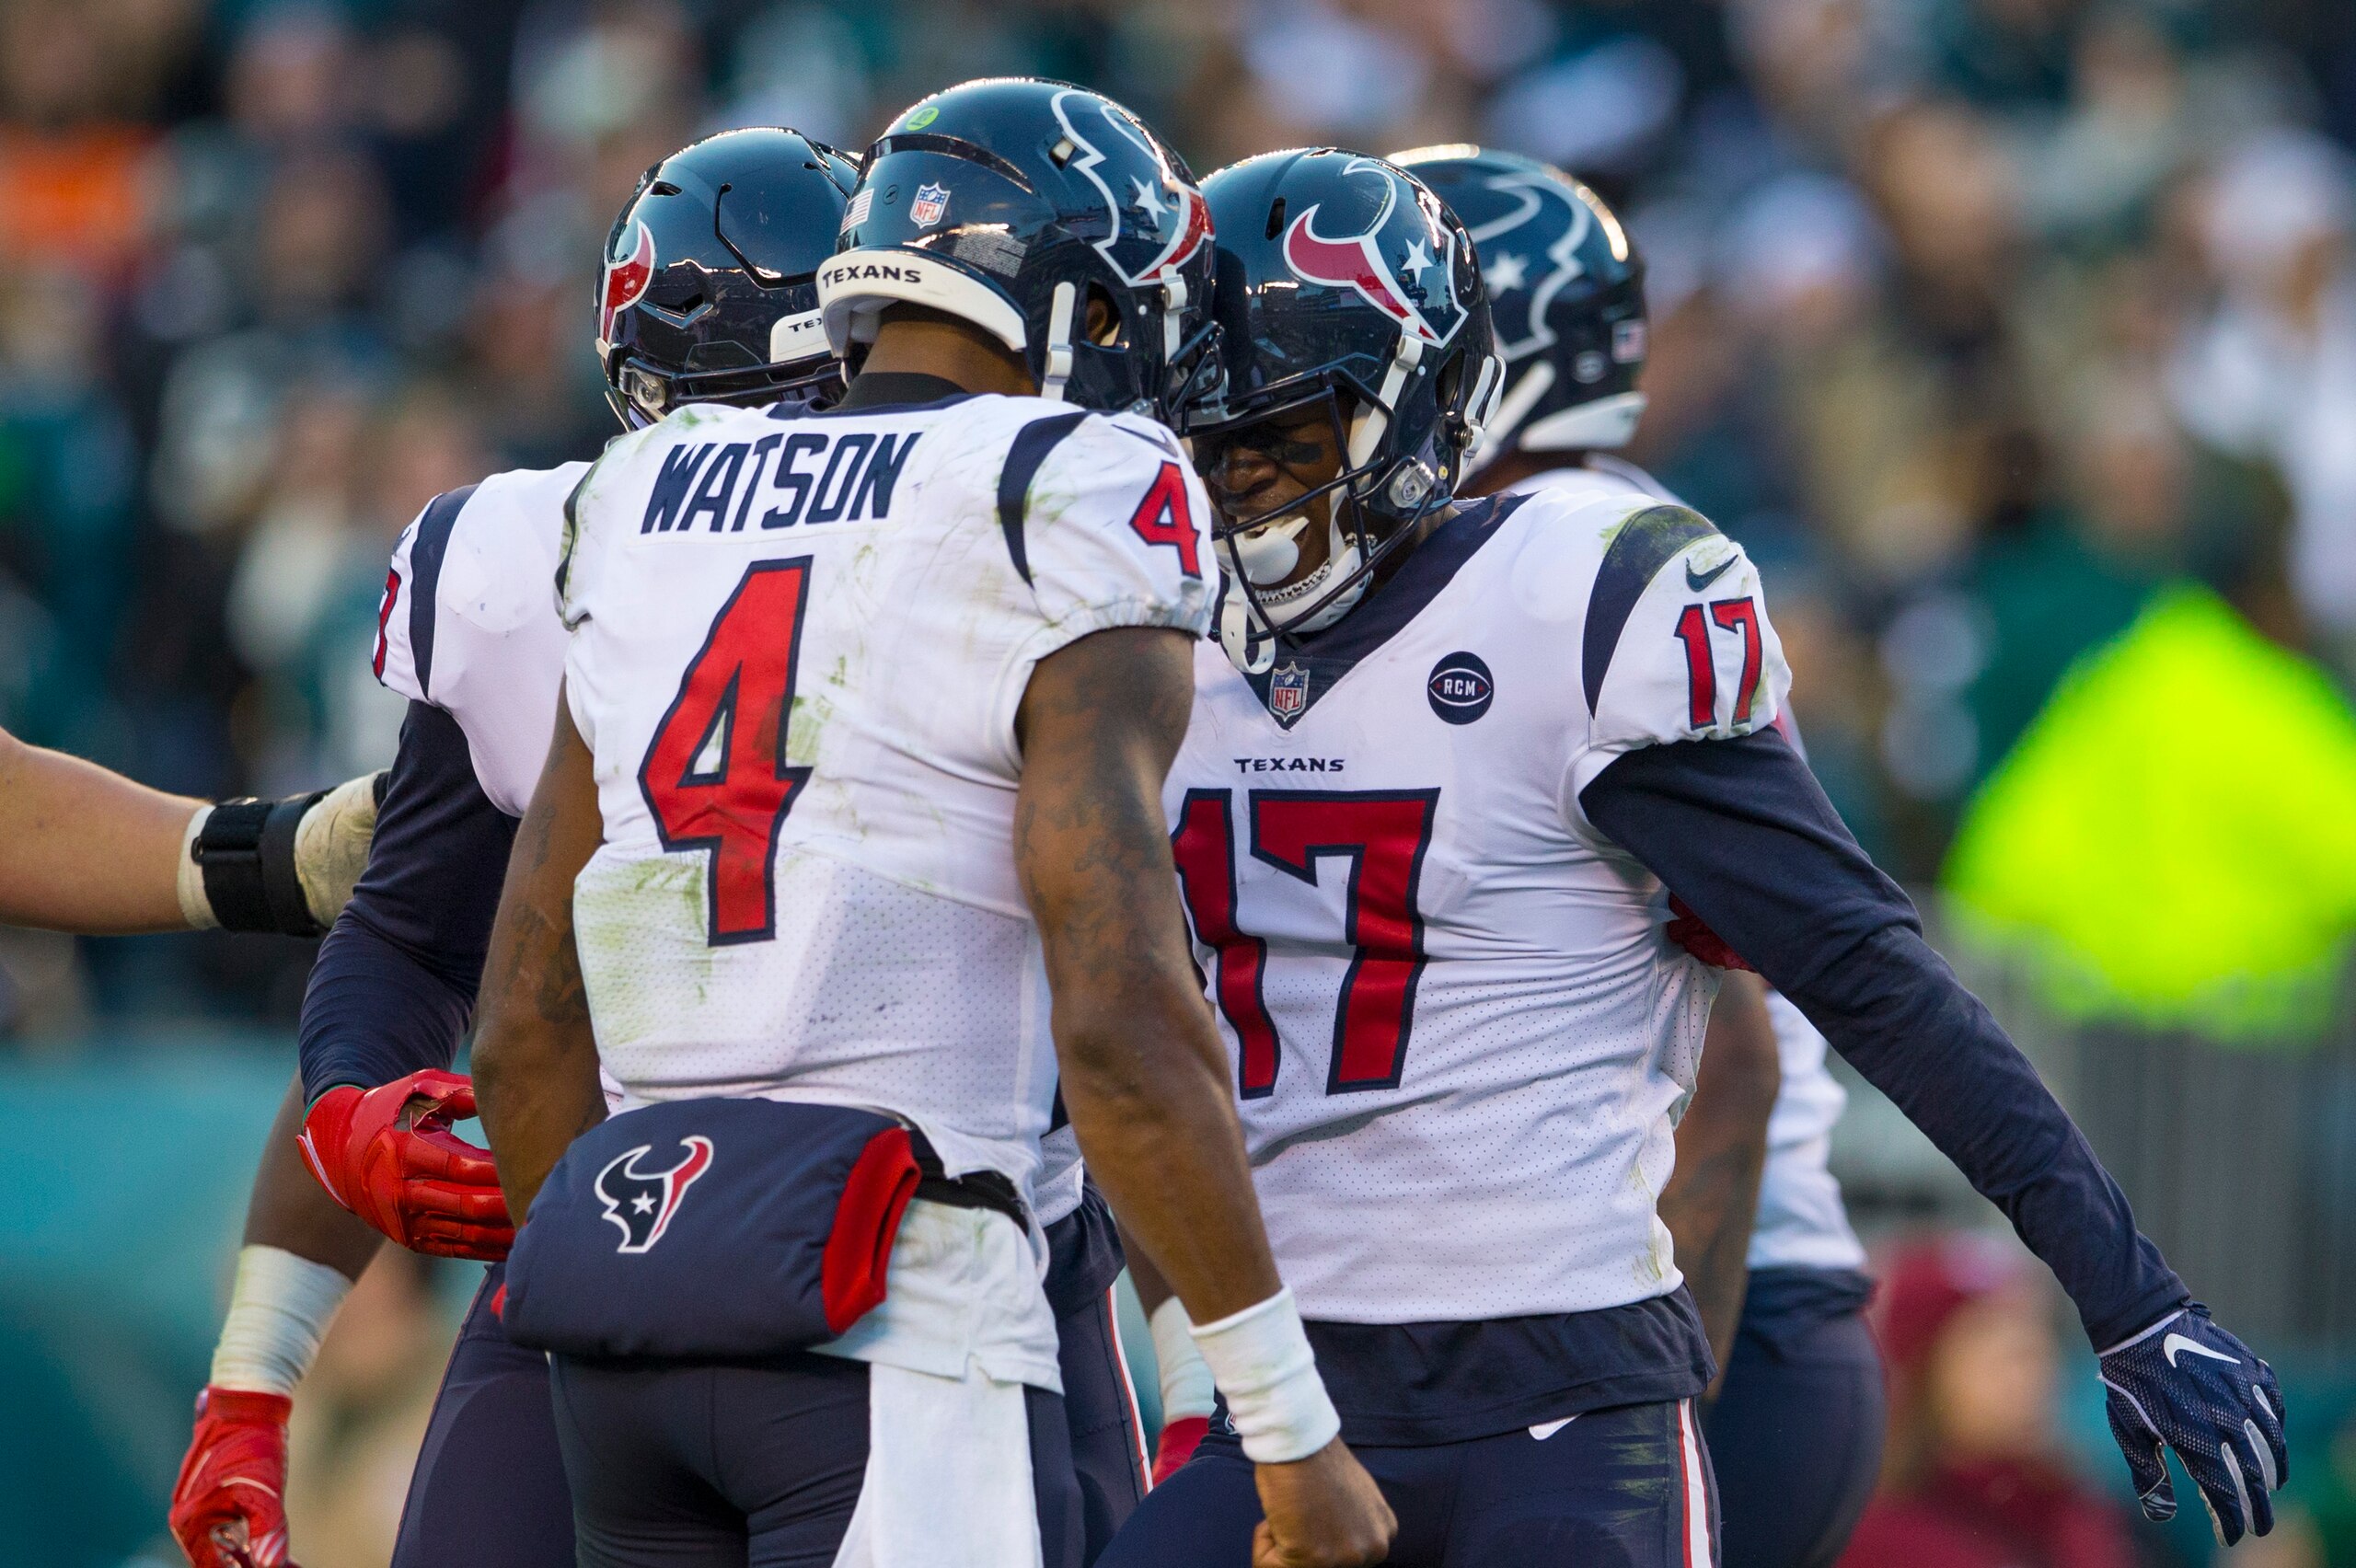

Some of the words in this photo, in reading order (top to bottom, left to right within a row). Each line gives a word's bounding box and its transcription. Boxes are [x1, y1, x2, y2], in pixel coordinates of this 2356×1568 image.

[914, 202, 938, 221] NFL
[823, 265, 921, 288] TEXANS
[641, 432, 924, 535] WATSON
[1128, 459, 1203, 581] 4
[1443, 678, 1476, 697] RCM
[1674, 596, 1763, 731] 17
[1275, 688, 1300, 710] NFL
[637, 554, 814, 947] 4
[1233, 757, 1345, 773] TEXANS
[1170, 787, 1441, 1101] 17
